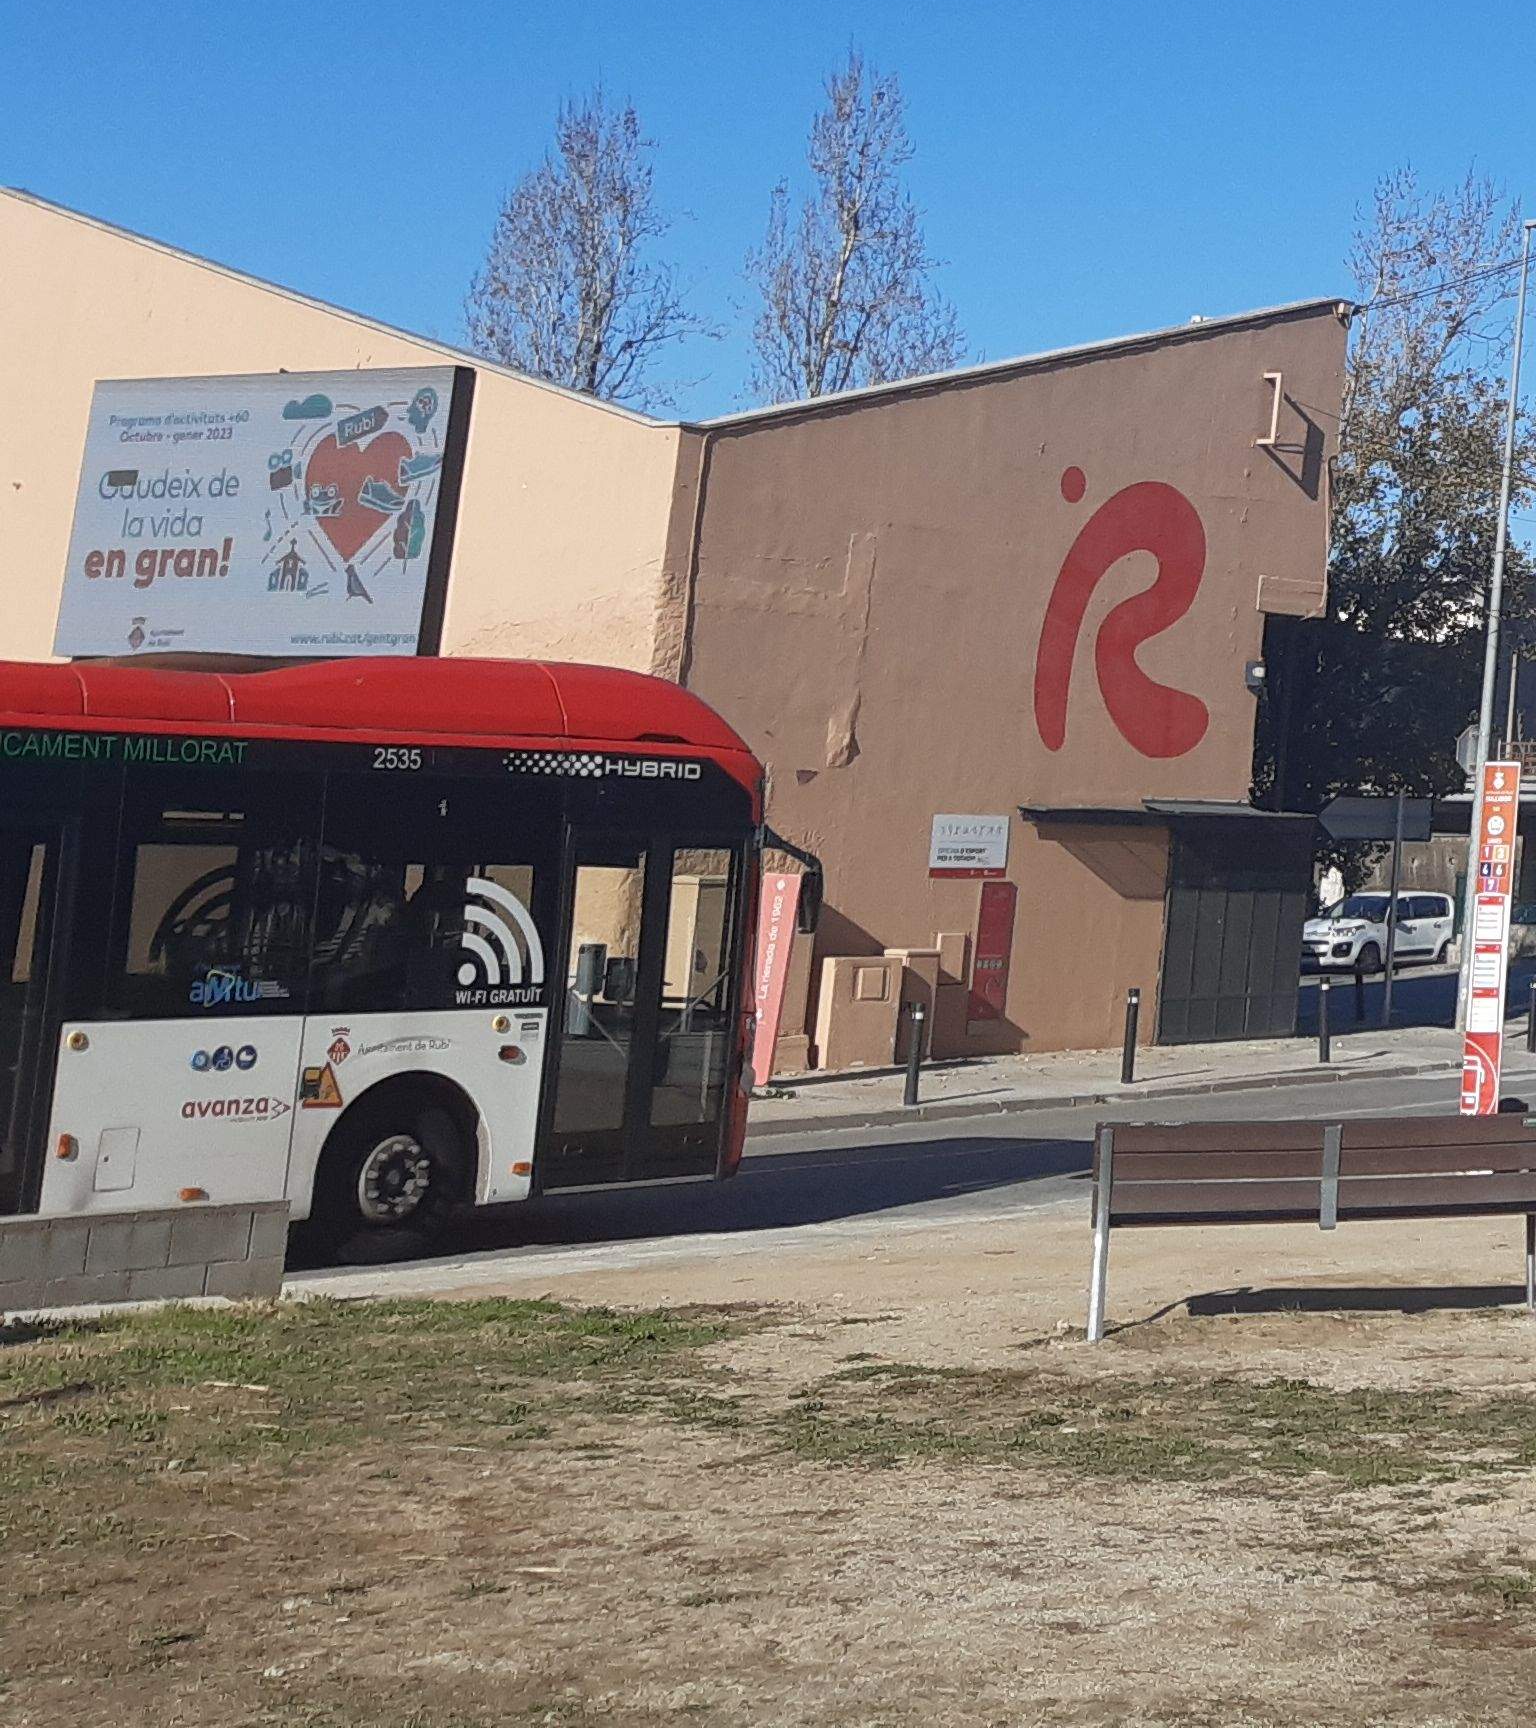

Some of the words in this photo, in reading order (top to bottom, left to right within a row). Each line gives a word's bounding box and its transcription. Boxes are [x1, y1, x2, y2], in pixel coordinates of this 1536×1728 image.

[120, 431, 163, 443] Octubre
[206, 427, 233, 440] 2023
[208, 468, 240, 497] de
[121, 508, 144, 538] la
[150, 508, 203, 538] vida
[84, 550, 126, 578] en
[134, 537, 233, 589] gran!
[0, 732, 117, 758] CAMENT
[124, 736, 248, 764] MILLORAT
[373, 748, 422, 770] 2535
[605, 759, 702, 780] HYBRID
[456, 990, 487, 1005] WI-FI
[181, 1097, 269, 1119] avanza
